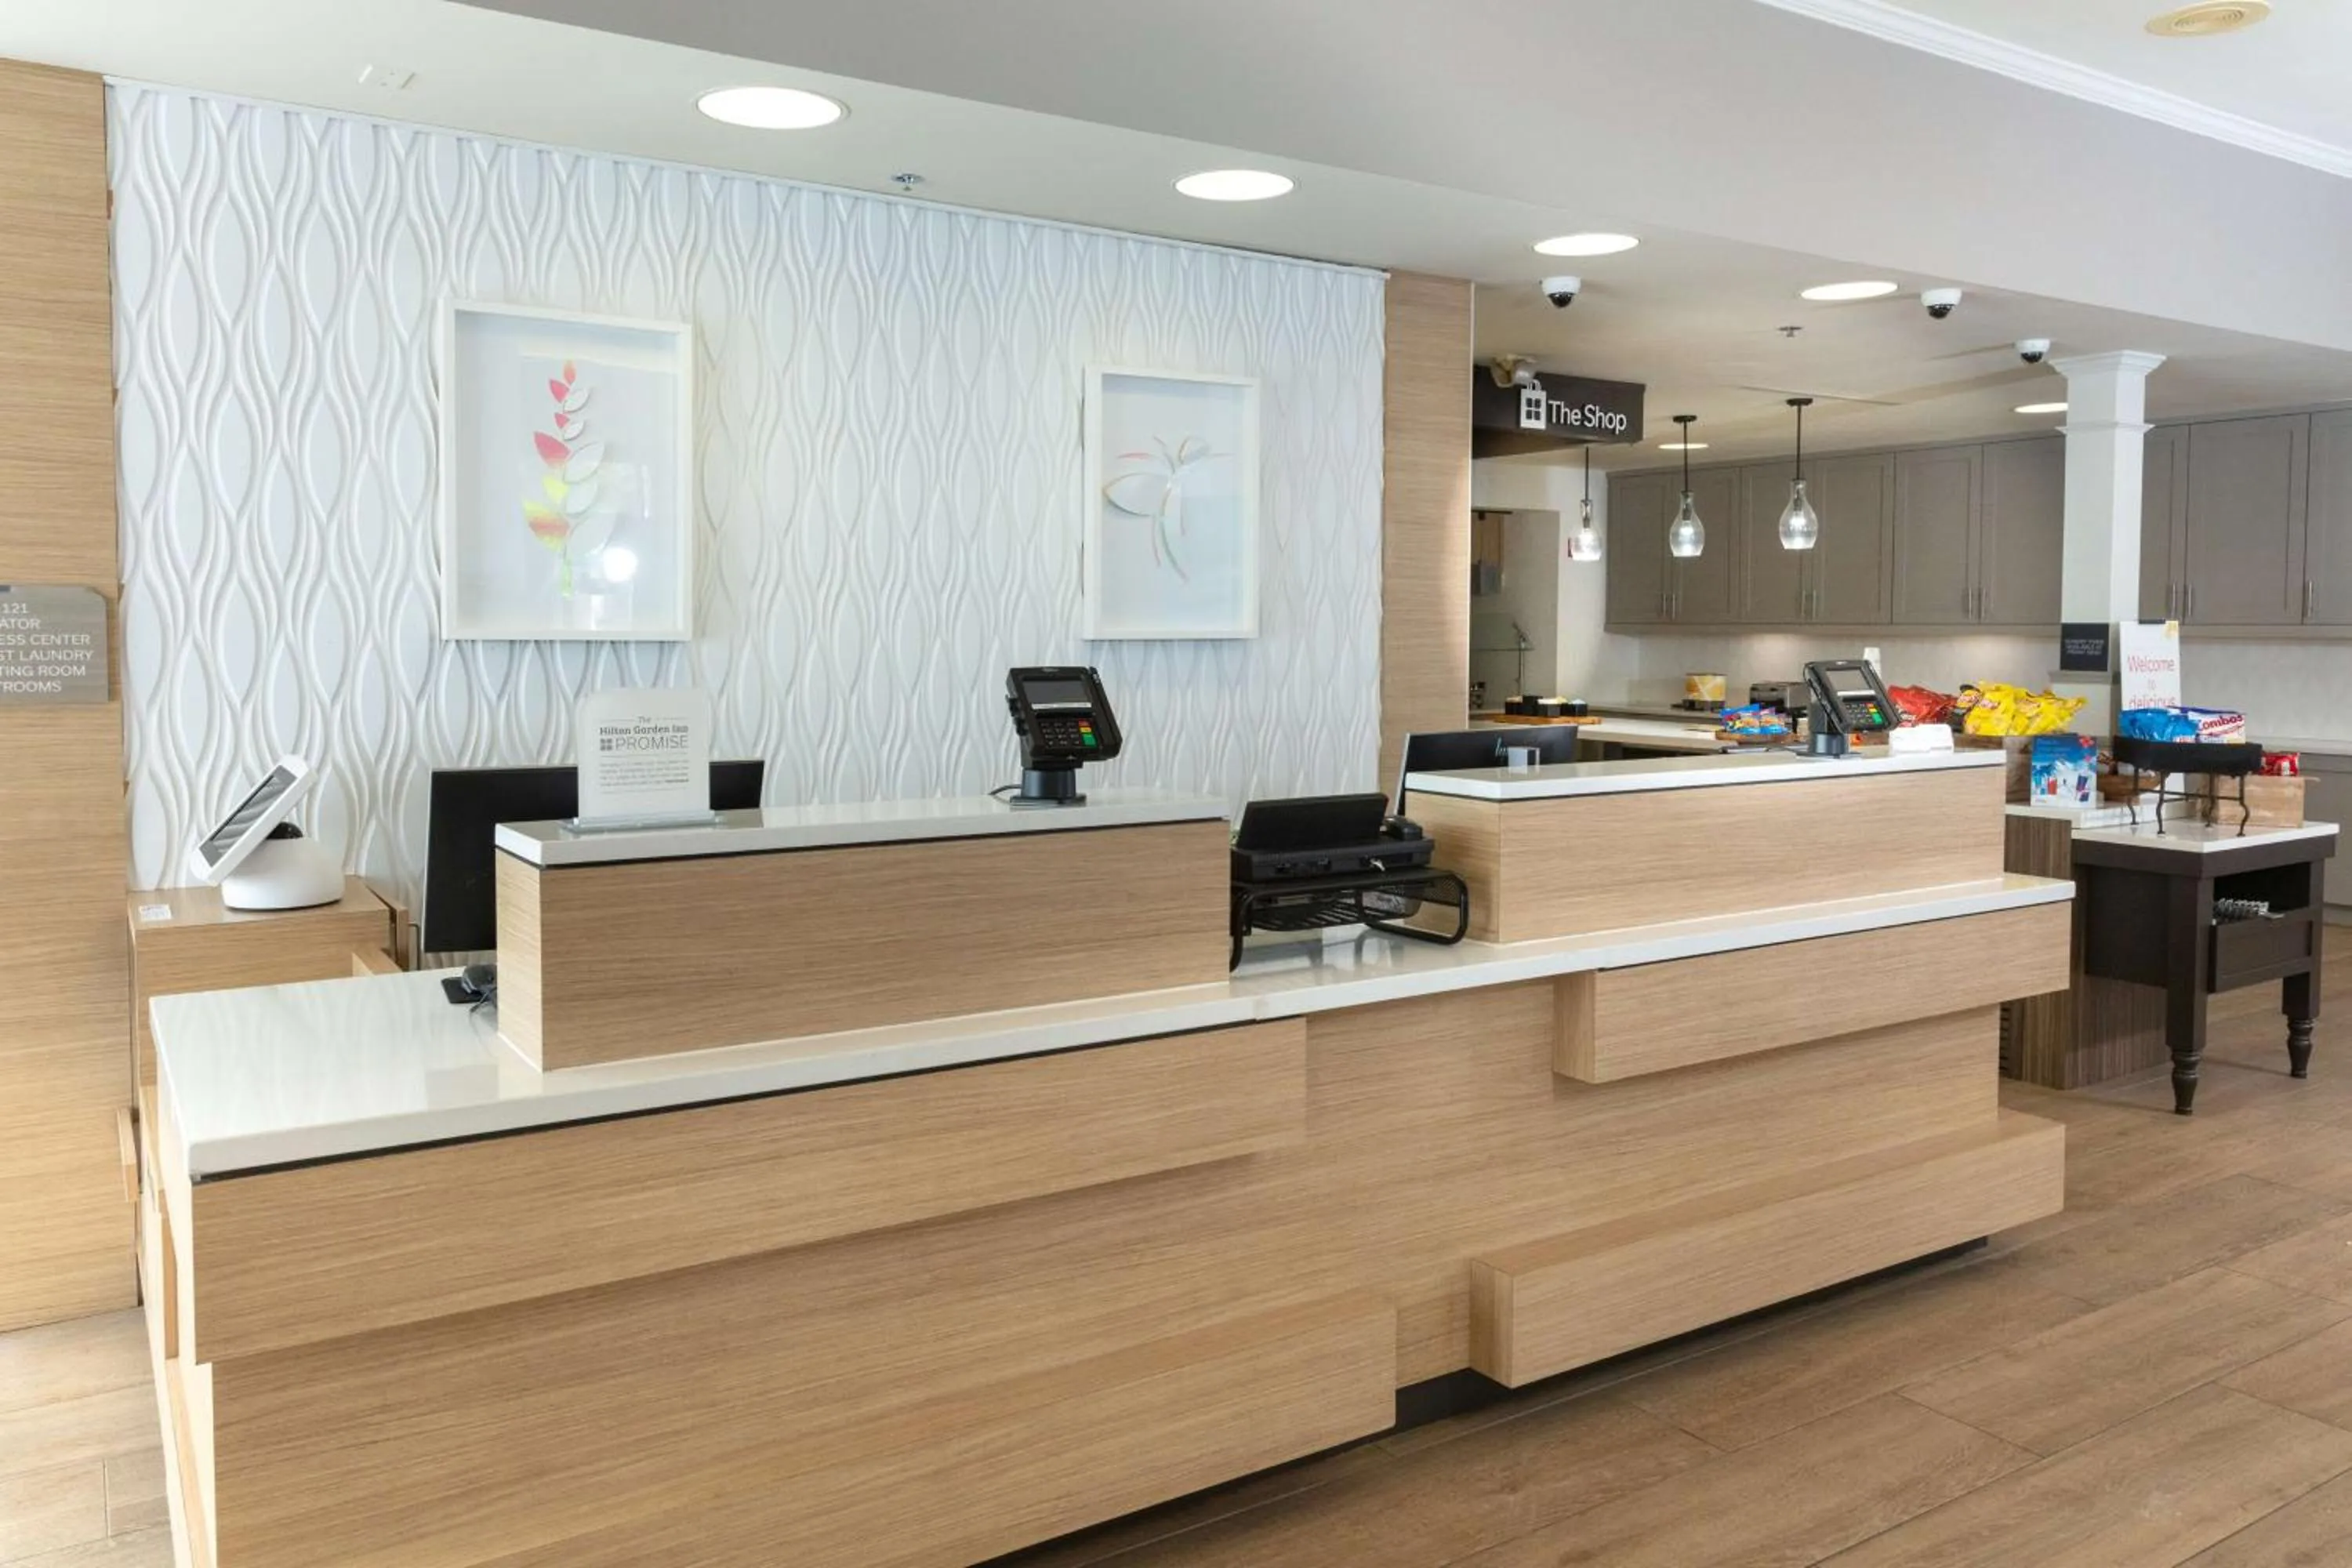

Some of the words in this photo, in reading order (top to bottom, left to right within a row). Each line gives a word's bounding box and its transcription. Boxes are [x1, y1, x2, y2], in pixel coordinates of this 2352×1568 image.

[1548, 400, 1581, 425] The
[1584, 403, 1627, 434] Shop
[2, 602, 29, 614] 121
[30, 633, 91, 646] CENTER
[20, 649, 94, 662] LAUNDRY
[2127, 655, 2175, 673] Welcome
[38, 665, 85, 677] ROOM
[600, 727, 631, 735] Hilton
[633, 724, 670, 735] Garden
[615, 735, 689, 751] PROMISE
